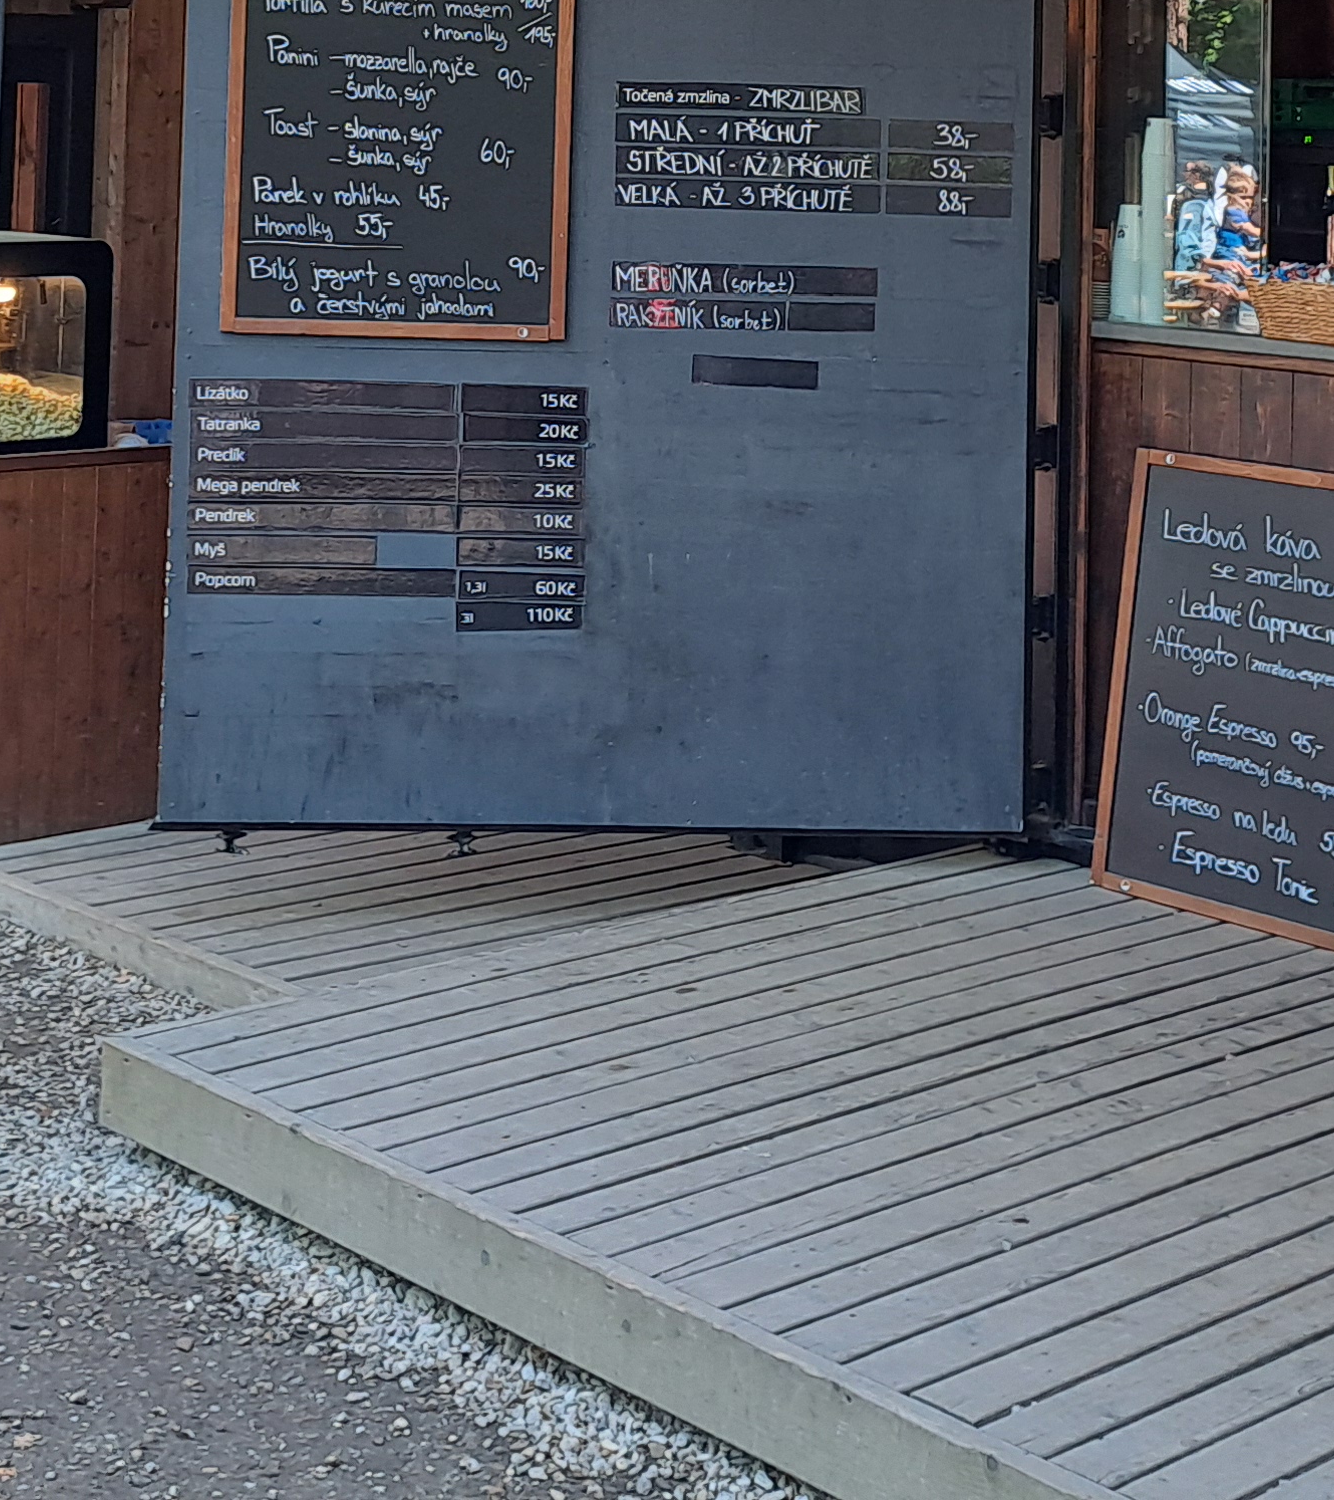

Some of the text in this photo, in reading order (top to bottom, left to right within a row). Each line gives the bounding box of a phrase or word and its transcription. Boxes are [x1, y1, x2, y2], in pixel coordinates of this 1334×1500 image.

[445, 1, 513, 20] masem
[266, 34, 319, 67] Panini
[497, 67, 534, 94] 90,-
[623, 87, 674, 104] Točená
[747, 87, 862, 114] ZMRZLIBAR
[263, 107, 319, 138] Toast
[479, 138, 516, 170] 60,-
[629, 115, 694, 143] MALÁ
[716, 121, 728, 142] 1
[626, 146, 726, 177] STŘEDNÍ
[743, 151, 768, 177] AŽ
[771, 155, 786, 177] 2
[312, 191, 325, 205] v
[333, 180, 401, 207] rohlíku
[617, 181, 681, 207] VELKÁ
[702, 182, 732, 207] AŽ
[737, 186, 755, 206] 3
[254, 212, 334, 242] Hranolky
[309, 259, 379, 292] jogurt
[386, 271, 401, 287] s
[408, 260, 502, 295] granolou
[616, 264, 795, 295] MERUŇKA (sorbet)
[289, 291, 494, 320] a čerstvými jahodami
[713, 304, 782, 331] (sorbet)
[196, 386, 249, 400] Lízátko
[196, 416, 261, 431] Tatranka
[196, 478, 239, 495] Mega
[240, 477, 301, 495] pendrek
[194, 507, 256, 523] Pendrek
[1162, 508, 1247, 551] Ledová
[1265, 515, 1322, 560] káva
[194, 541, 226, 558] Myš
[194, 572, 256, 589] Popcorn
[1210, 562, 1239, 580] se
[1180, 588, 1243, 628] Ledové
[1152, 625, 1239, 676] Affogato
[1144, 691, 1204, 743] Orange
[1207, 704, 1278, 749] Espresso
[1152, 781, 1221, 817] Espresso
[1233, 811, 1257, 832] na
[1262, 809, 1298, 847] ledu
[1172, 830, 1260, 884] Espresso
[1271, 857, 1319, 905] Tonic
